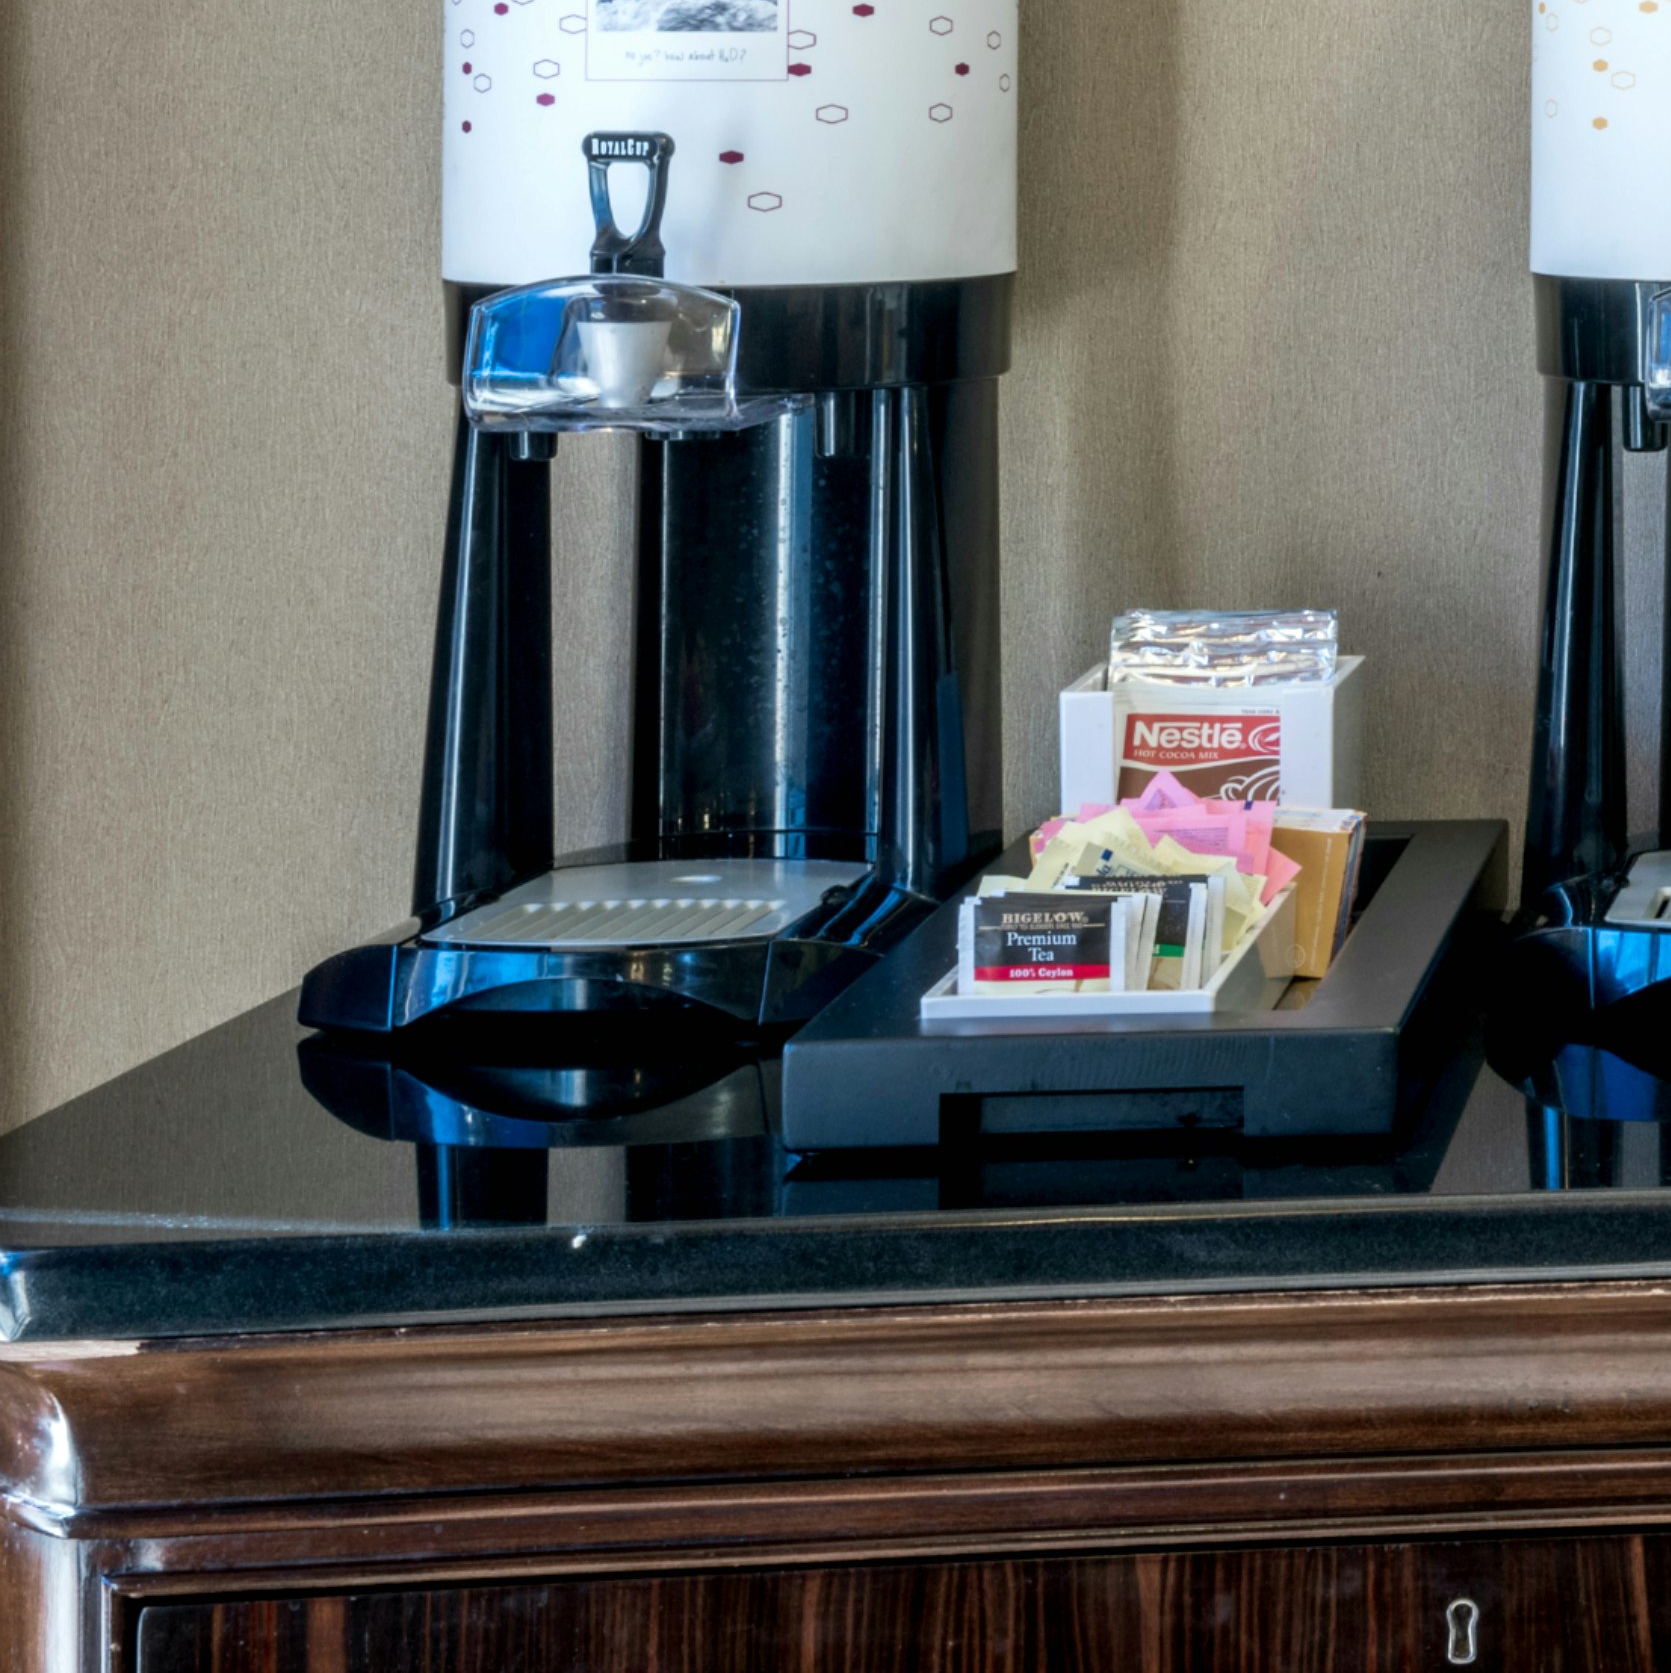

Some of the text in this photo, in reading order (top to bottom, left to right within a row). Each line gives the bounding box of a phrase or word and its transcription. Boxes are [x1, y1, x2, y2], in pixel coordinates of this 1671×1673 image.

[688, 48, 715, 61] about
[1134, 749, 1219, 760] HOT COCOA MIX
[1002, 911, 1085, 924] BIGELOW
[1006, 931, 1076, 947] Premium
[1028, 948, 1054, 962] Tea
[1009, 967, 1073, 978] 100% Ceylon
